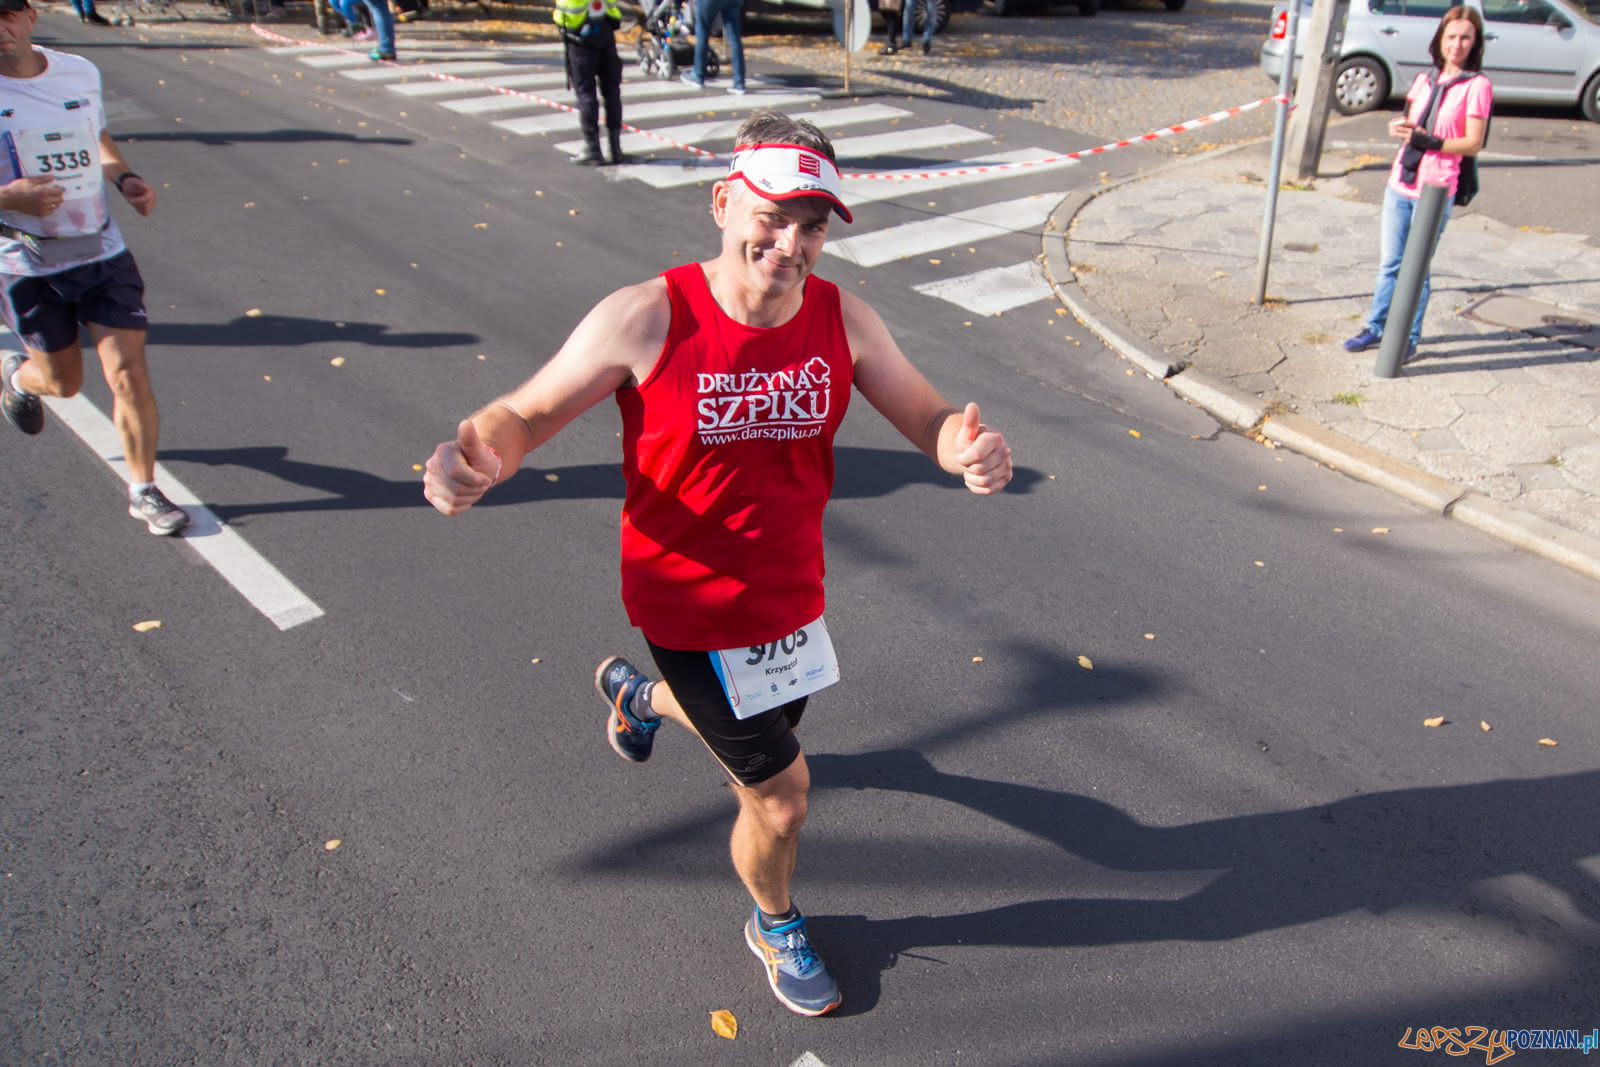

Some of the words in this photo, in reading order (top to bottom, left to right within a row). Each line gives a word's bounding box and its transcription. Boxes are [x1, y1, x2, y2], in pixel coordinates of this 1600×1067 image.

[36, 149, 90, 172] 3338
[697, 368, 813, 393] DRUŻYNA
[697, 389, 831, 430] SZPIKU
[701, 425, 821, 445] www.darszpiku.pl
